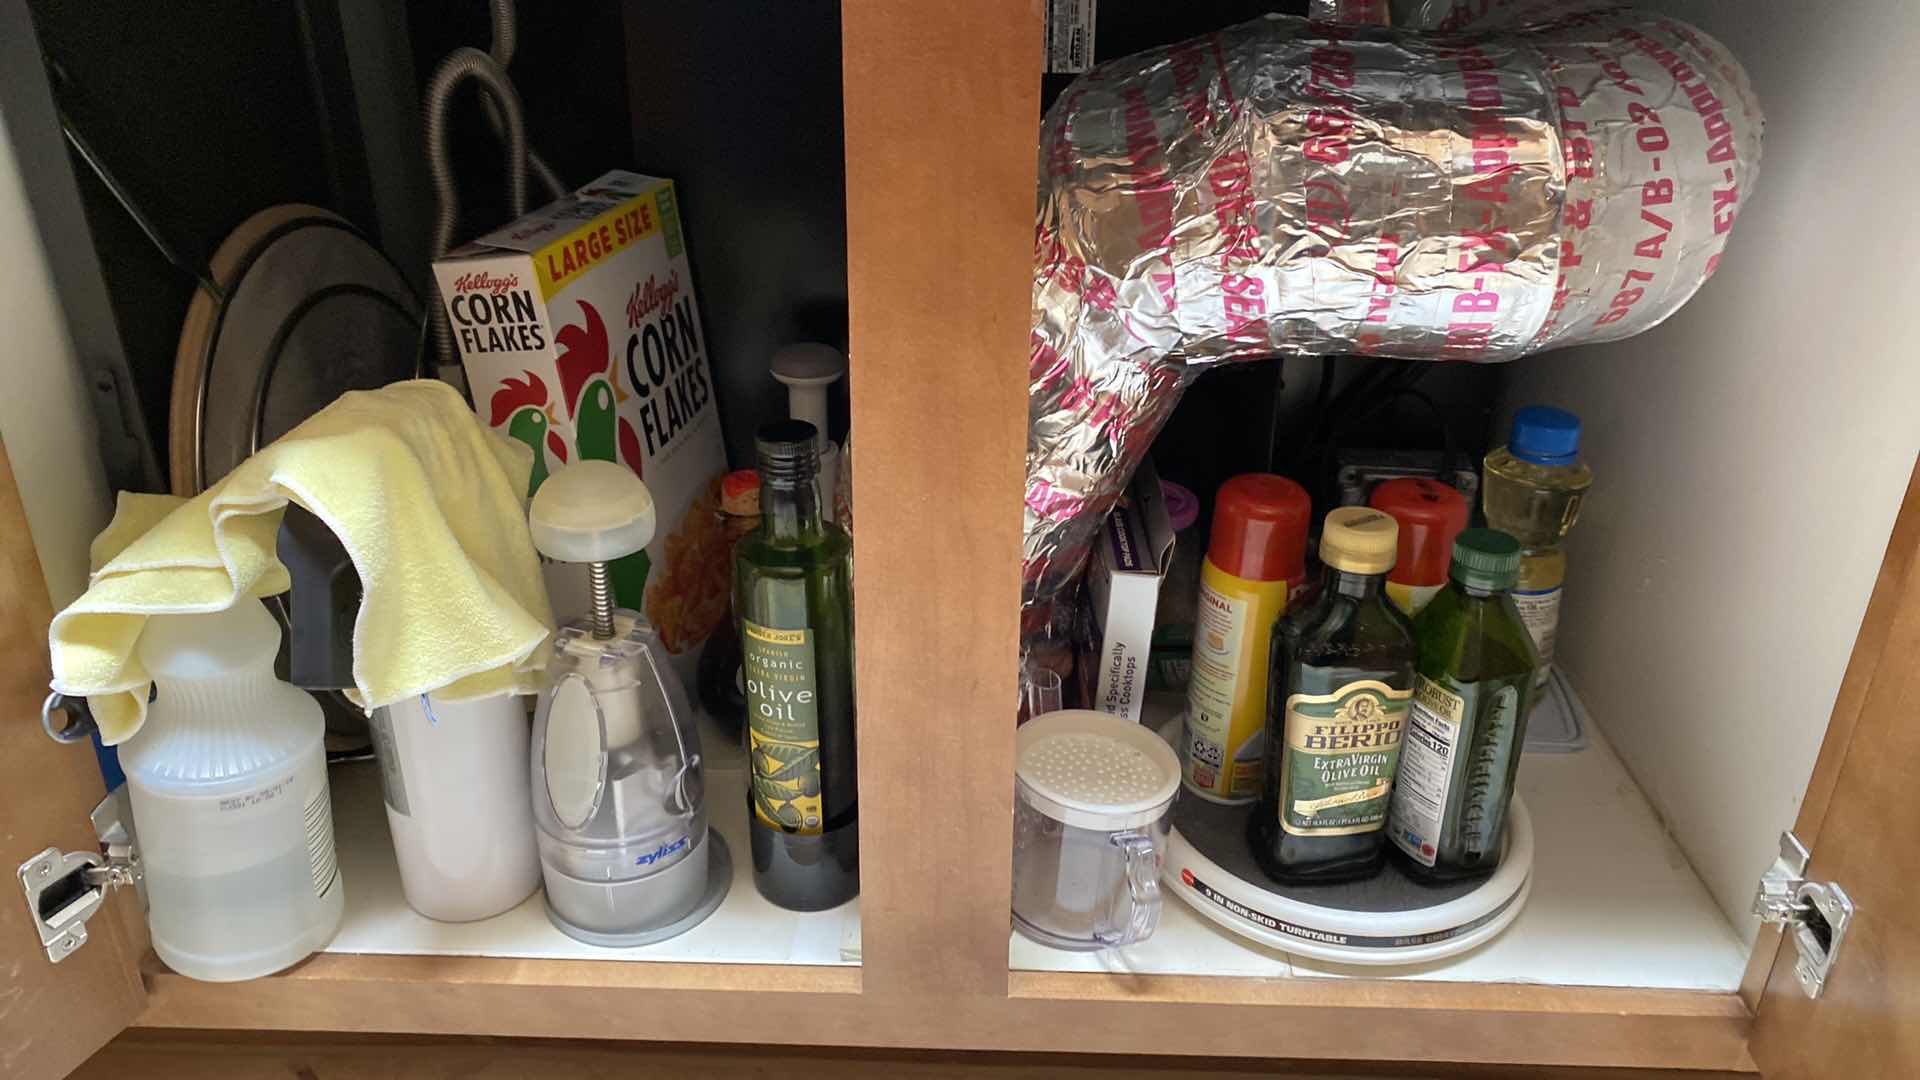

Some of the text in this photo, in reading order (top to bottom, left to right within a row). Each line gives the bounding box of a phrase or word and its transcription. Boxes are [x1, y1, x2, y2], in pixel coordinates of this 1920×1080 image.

[548, 224, 613, 281] LARGE
[614, 204, 653, 245] SIZE
[454, 271, 519, 294] Kellogg's
[451, 290, 538, 326] CORN
[460, 324, 545, 354] FLAKES
[626, 295, 699, 399] CORN
[640, 357, 709, 457] FLAKES
[750, 652, 804, 670] organic
[1106, 641, 1127, 708] Specifically
[747, 680, 813, 704] olive
[1120, 656, 1137, 705] Cooktops
[760, 703, 796, 722] oil
[1305, 730, 1400, 750] BERIO
[1314, 720, 1400, 736] FILIPPO
[1431, 740, 1449, 755] 120
[1213, 893, 1224, 905] IN
[1226, 900, 1276, 928] NON-SKID
[1278, 922, 1348, 945] TURNTABLE
